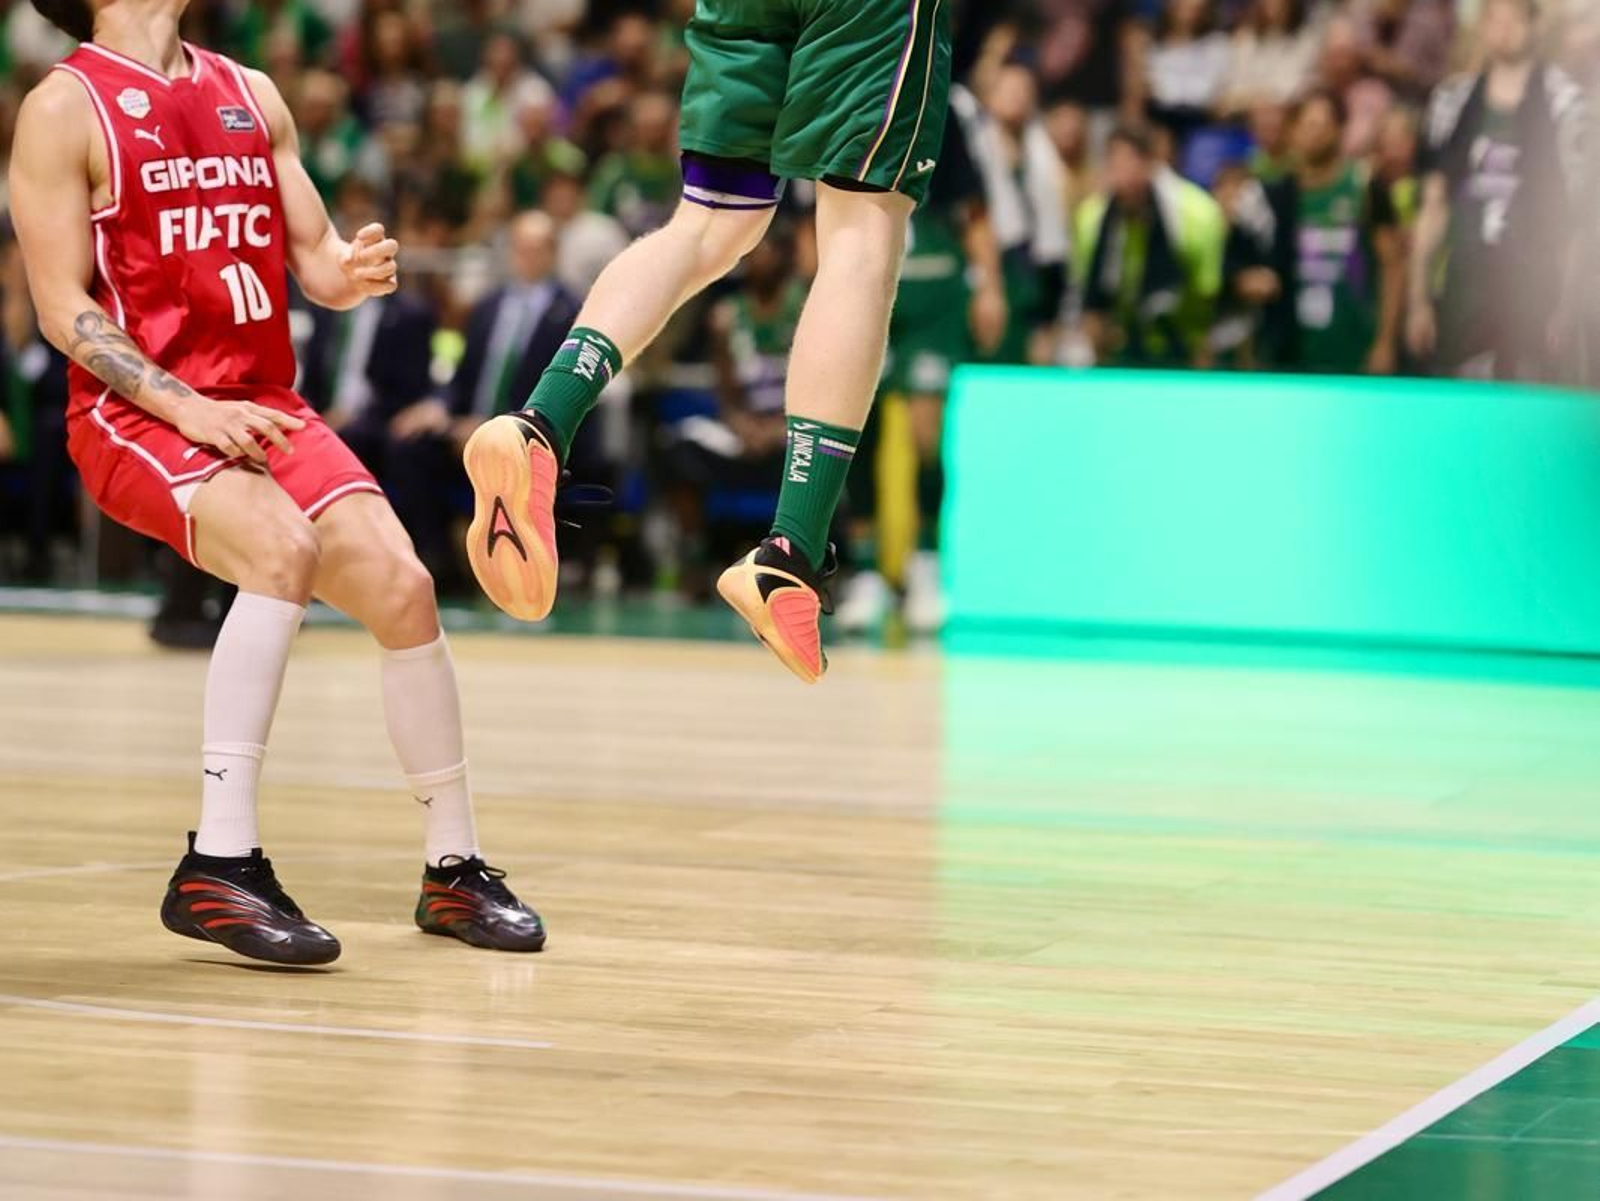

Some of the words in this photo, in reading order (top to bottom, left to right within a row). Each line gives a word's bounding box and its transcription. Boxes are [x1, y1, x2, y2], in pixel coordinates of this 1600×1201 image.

[158, 203, 272, 256] FIATC
[218, 261, 273, 325] 10
[787, 430, 814, 483] UNICAJA
